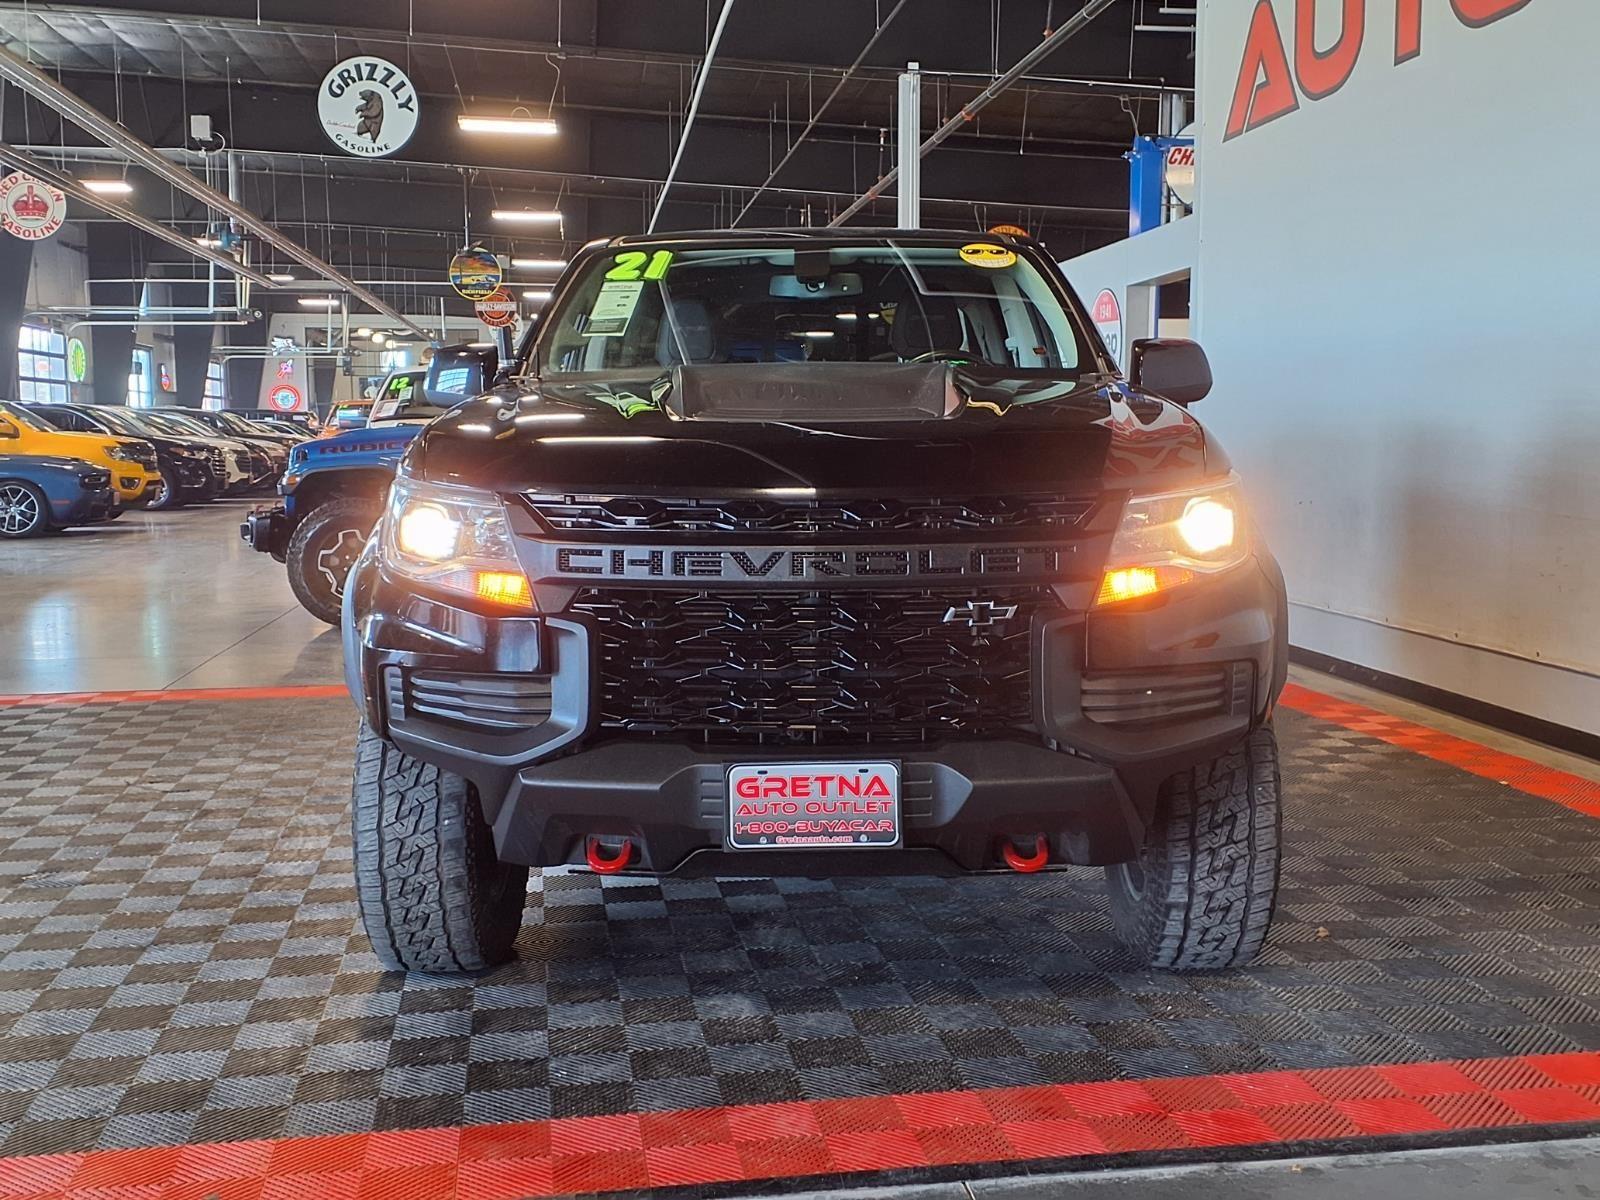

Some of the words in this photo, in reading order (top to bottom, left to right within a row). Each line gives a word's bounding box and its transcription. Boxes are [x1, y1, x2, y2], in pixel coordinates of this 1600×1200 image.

[1222, 0, 1531, 143] AU
[328, 63, 415, 113] GRIZZLY
[335, 133, 391, 153] GASOLINE
[605, 250, 673, 280] 21
[390, 377, 409, 390] 12
[556, 545, 1077, 577] CHEVROLET
[736, 775, 892, 798] GRETNA
[735, 802, 798, 816] AUTO
[805, 801, 893, 815] OUTLET
[735, 820, 893, 834] 1-800-BUYACAR
